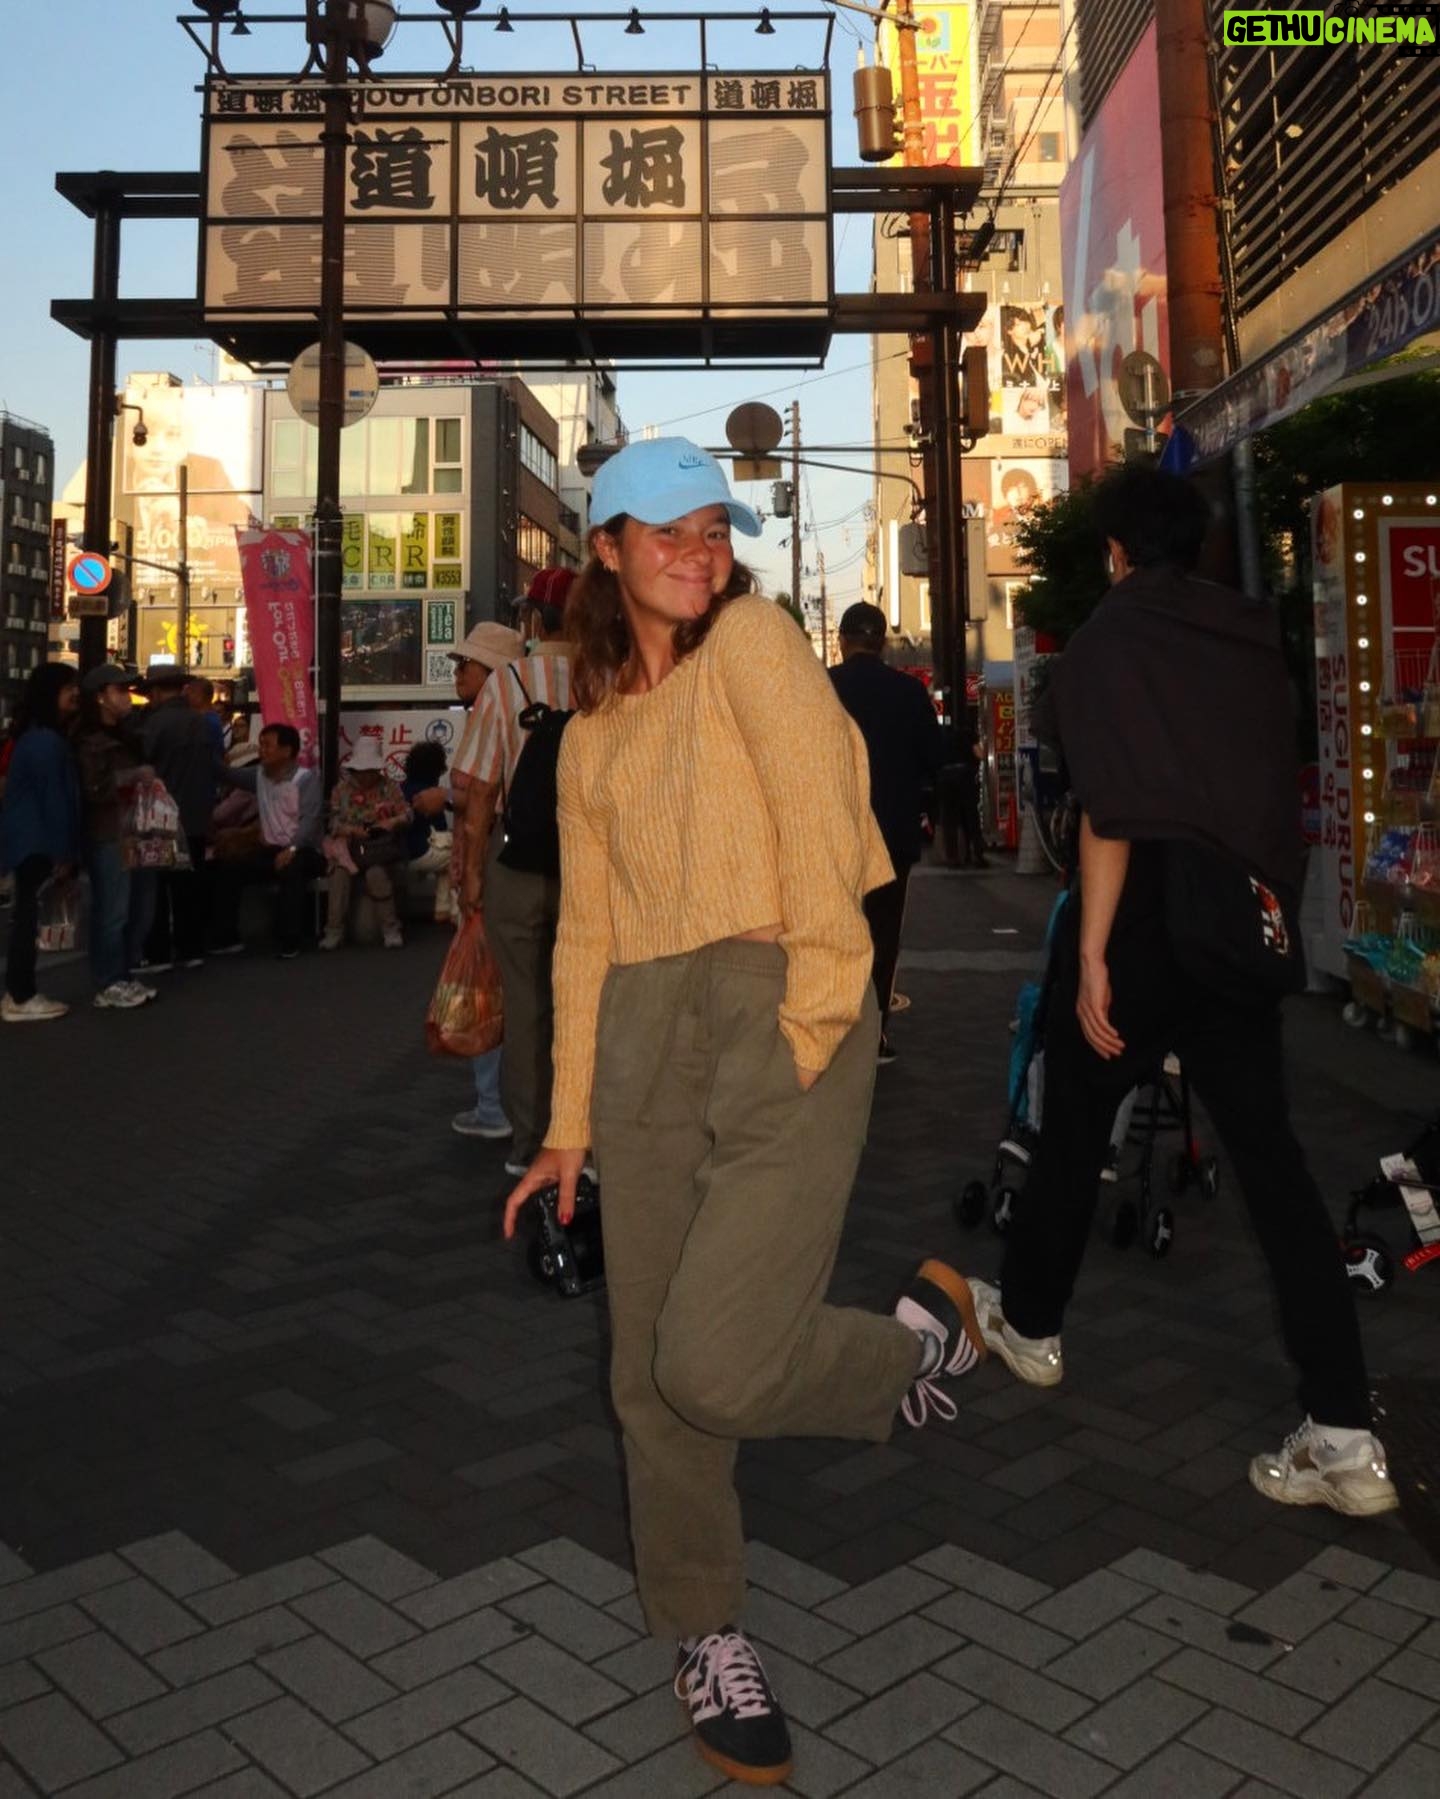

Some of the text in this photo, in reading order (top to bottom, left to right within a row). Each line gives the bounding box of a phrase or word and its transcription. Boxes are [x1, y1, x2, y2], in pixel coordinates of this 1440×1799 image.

[914, 53, 963, 70] ーパー
[562, 85, 692, 105] STREET
[714, 79, 818, 110] 道頓堀
[349, 124, 686, 210] 道頓堀
[1332, 654, 1354, 930] SUGI DRUG
